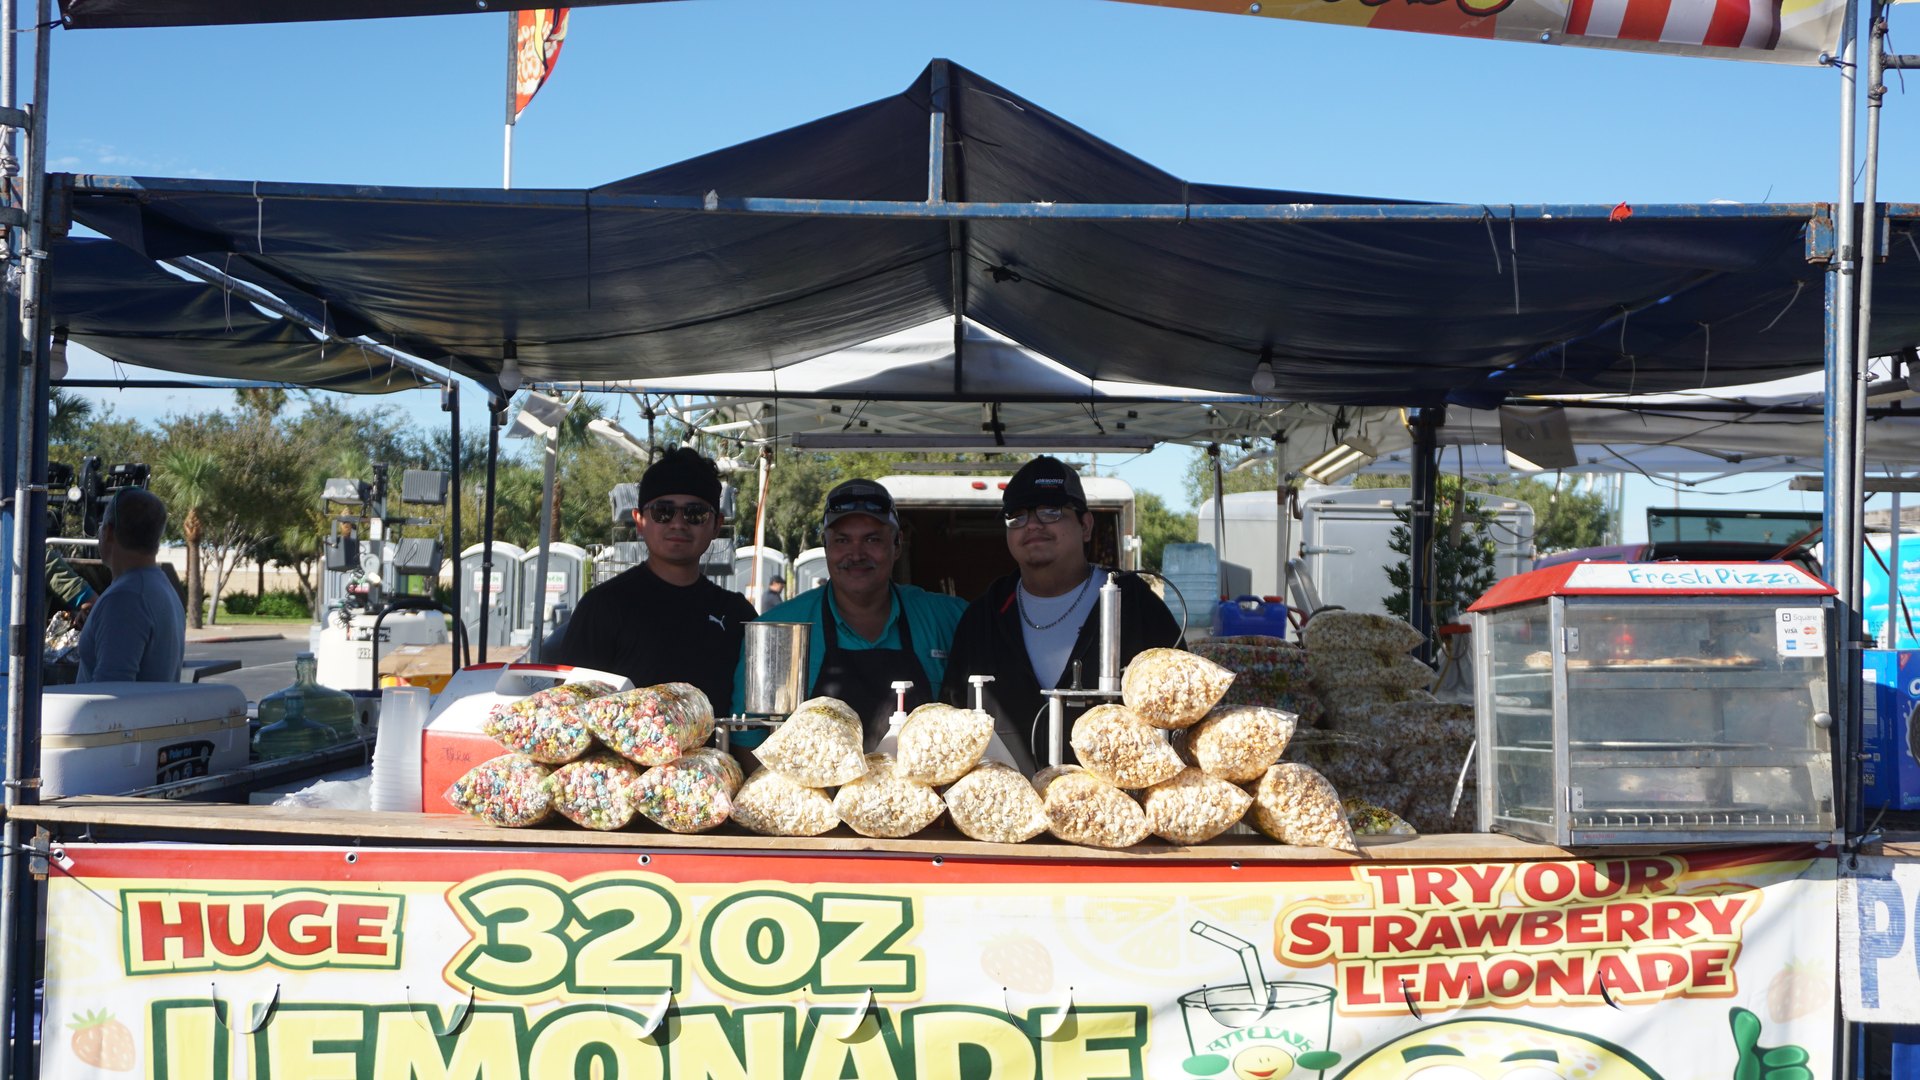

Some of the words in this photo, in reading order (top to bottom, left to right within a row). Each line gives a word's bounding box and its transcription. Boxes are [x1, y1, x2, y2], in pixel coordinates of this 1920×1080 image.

[1628, 568, 1710, 584] Fresh
[1714, 568, 1801, 584] Pizza
[1793, 613, 1817, 622] Square
[1368, 865, 1505, 905] TRY
[1524, 858, 1675, 901] OUR
[139, 900, 389, 961] HUGE
[455, 877, 683, 995] 32
[699, 888, 916, 994] OZ
[1289, 899, 1748, 955] STRAWBERRY
[1346, 949, 1730, 1005] LEMONADE
[152, 1003, 1147, 1080] LEMONADE
